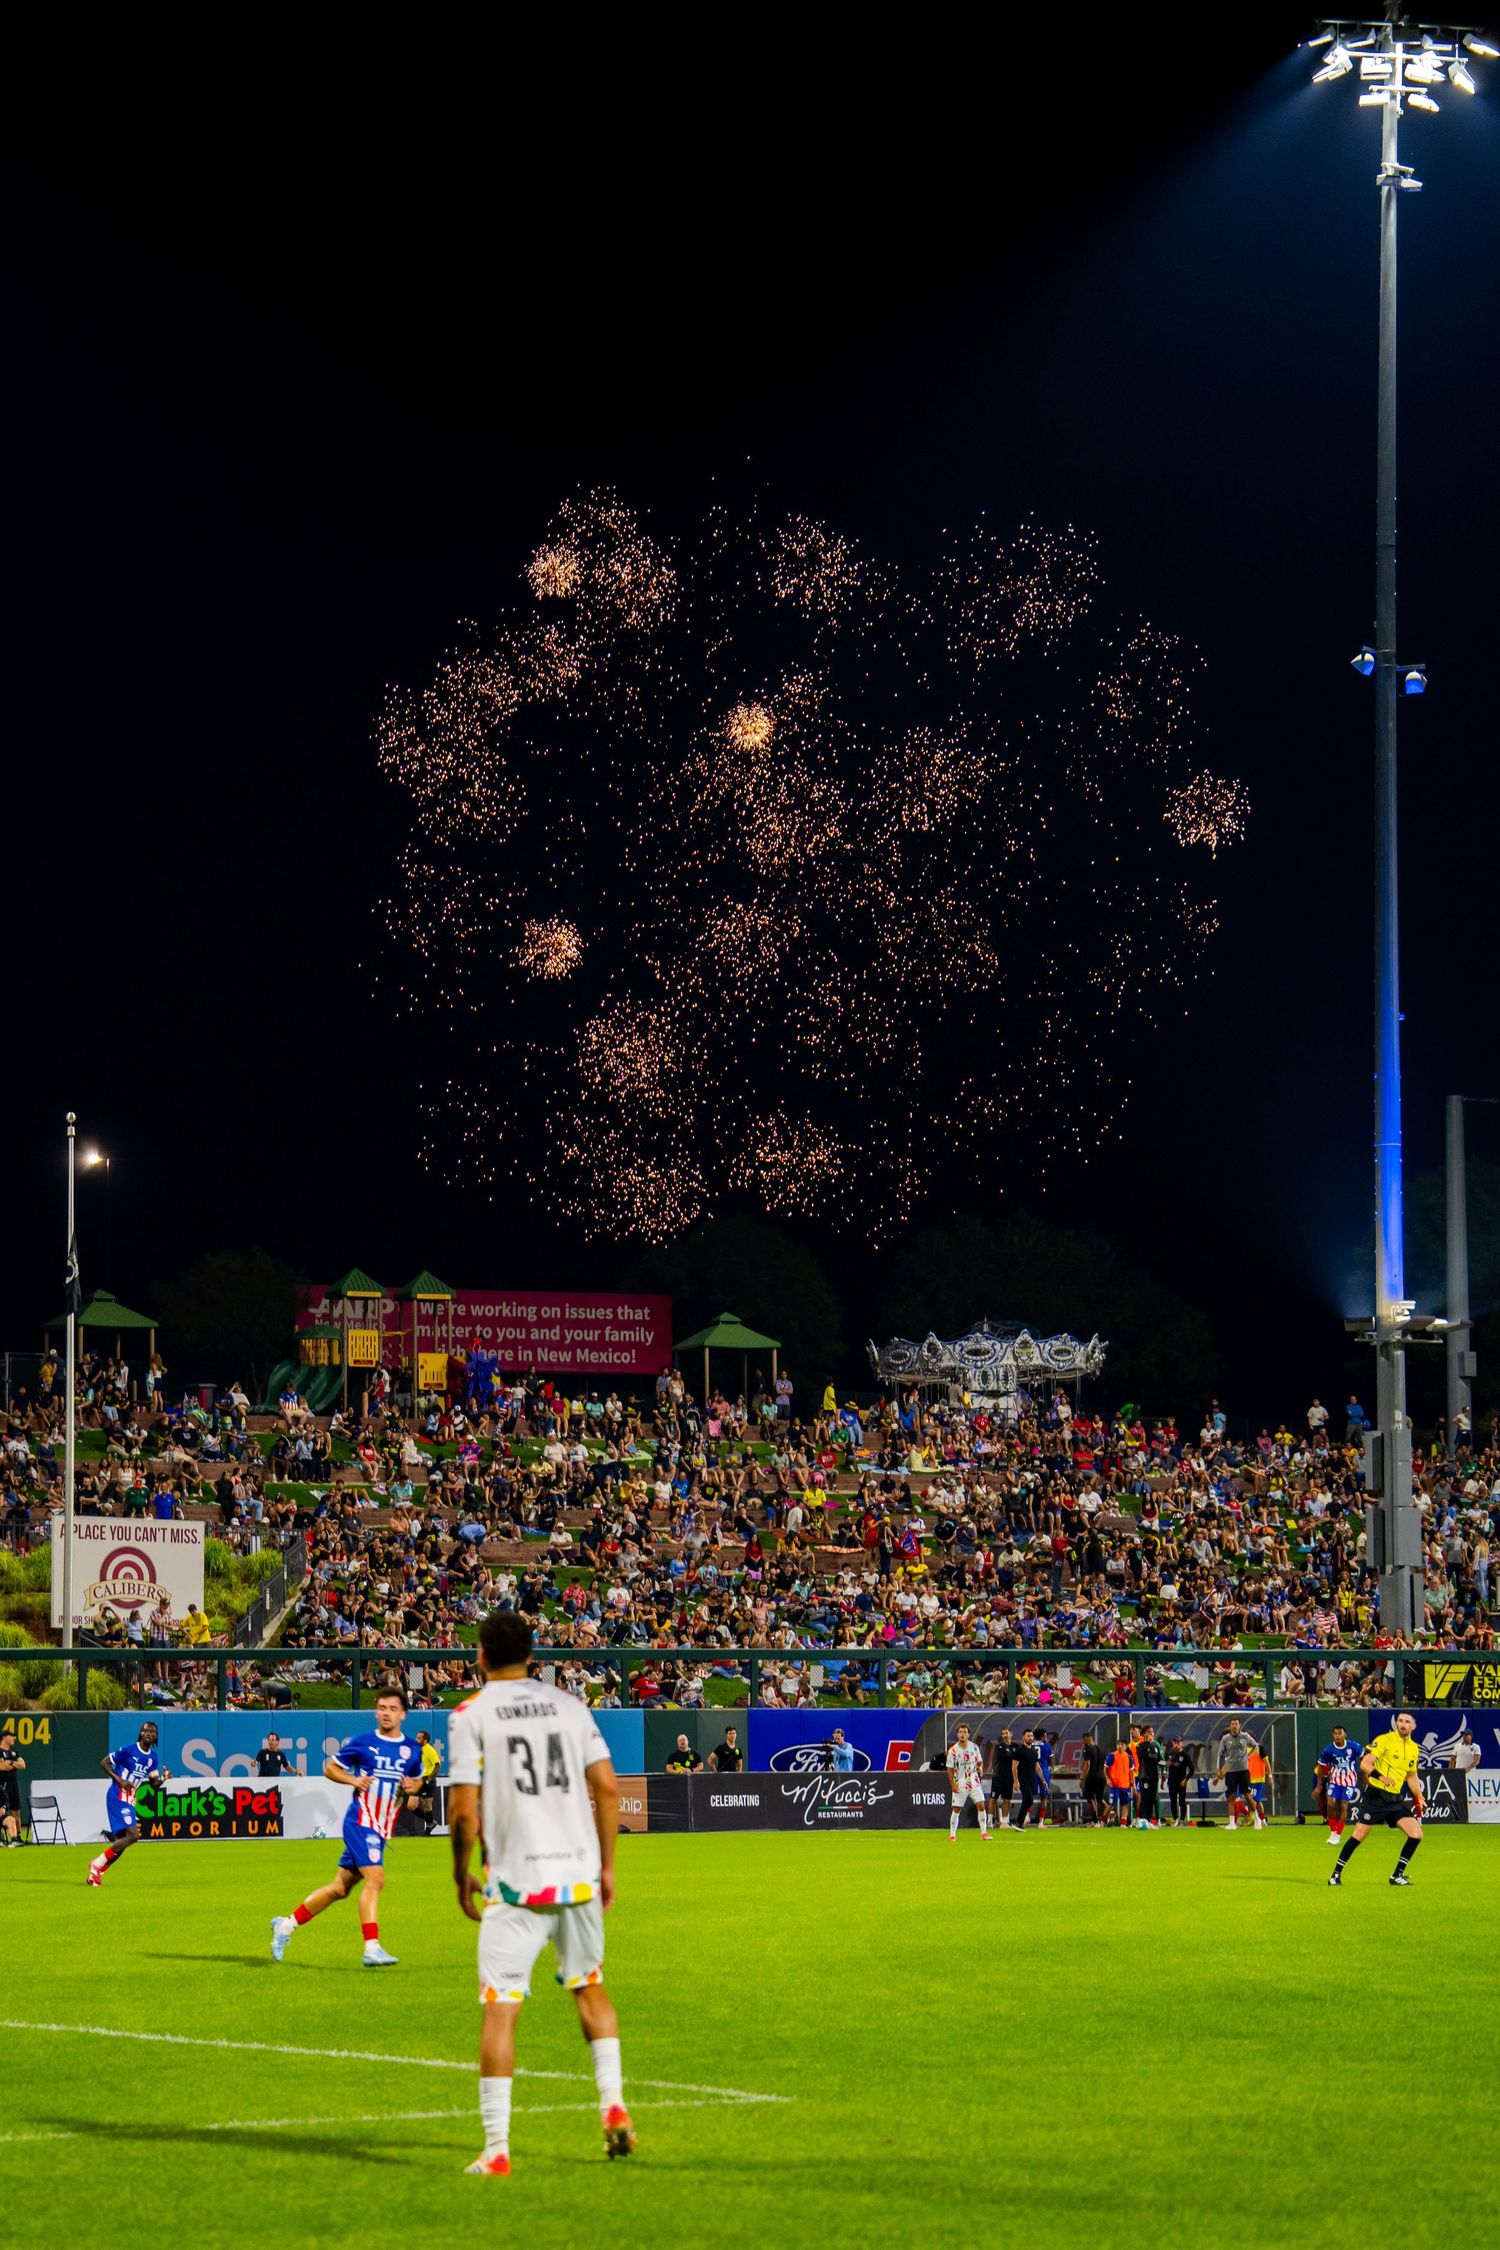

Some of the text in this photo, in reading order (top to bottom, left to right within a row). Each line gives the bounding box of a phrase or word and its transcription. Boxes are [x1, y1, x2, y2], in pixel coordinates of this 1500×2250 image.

[470, 1301, 538, 1322] working
[541, 1305, 561, 1319] on
[565, 1303, 614, 1320] issues
[616, 1304, 651, 1321] that
[474, 1324, 493, 1339] to
[496, 1327, 526, 1343] you
[530, 1324, 560, 1341] and
[564, 1328, 602, 1345] your
[604, 1325, 655, 1346] family
[518, 1345, 533, 1362] in
[537, 1346, 572, 1362] New
[576, 1347, 636, 1364] Mexico!
[72, 1524, 106, 1540] PLACE
[110, 1525, 131, 1542] YOU
[135, 1526, 168, 1543] CAN'T
[170, 1528, 201, 1544] MISS.
[93, 1582, 165, 1601] CALIBERS
[495, 1703, 559, 1721] EDWARDS
[135, 1762, 149, 1774] TLC
[374, 1755, 406, 1772] TLC
[506, 1731, 569, 1795] 34
[135, 1783, 279, 1818] Clark's Pet
[710, 1794, 760, 1807] CELEBRATING
[911, 1792, 946, 1806] 10 YEARS
[817, 1811, 864, 1819] RESTAURANTS
[137, 1820, 280, 1837] EMPORIUM
